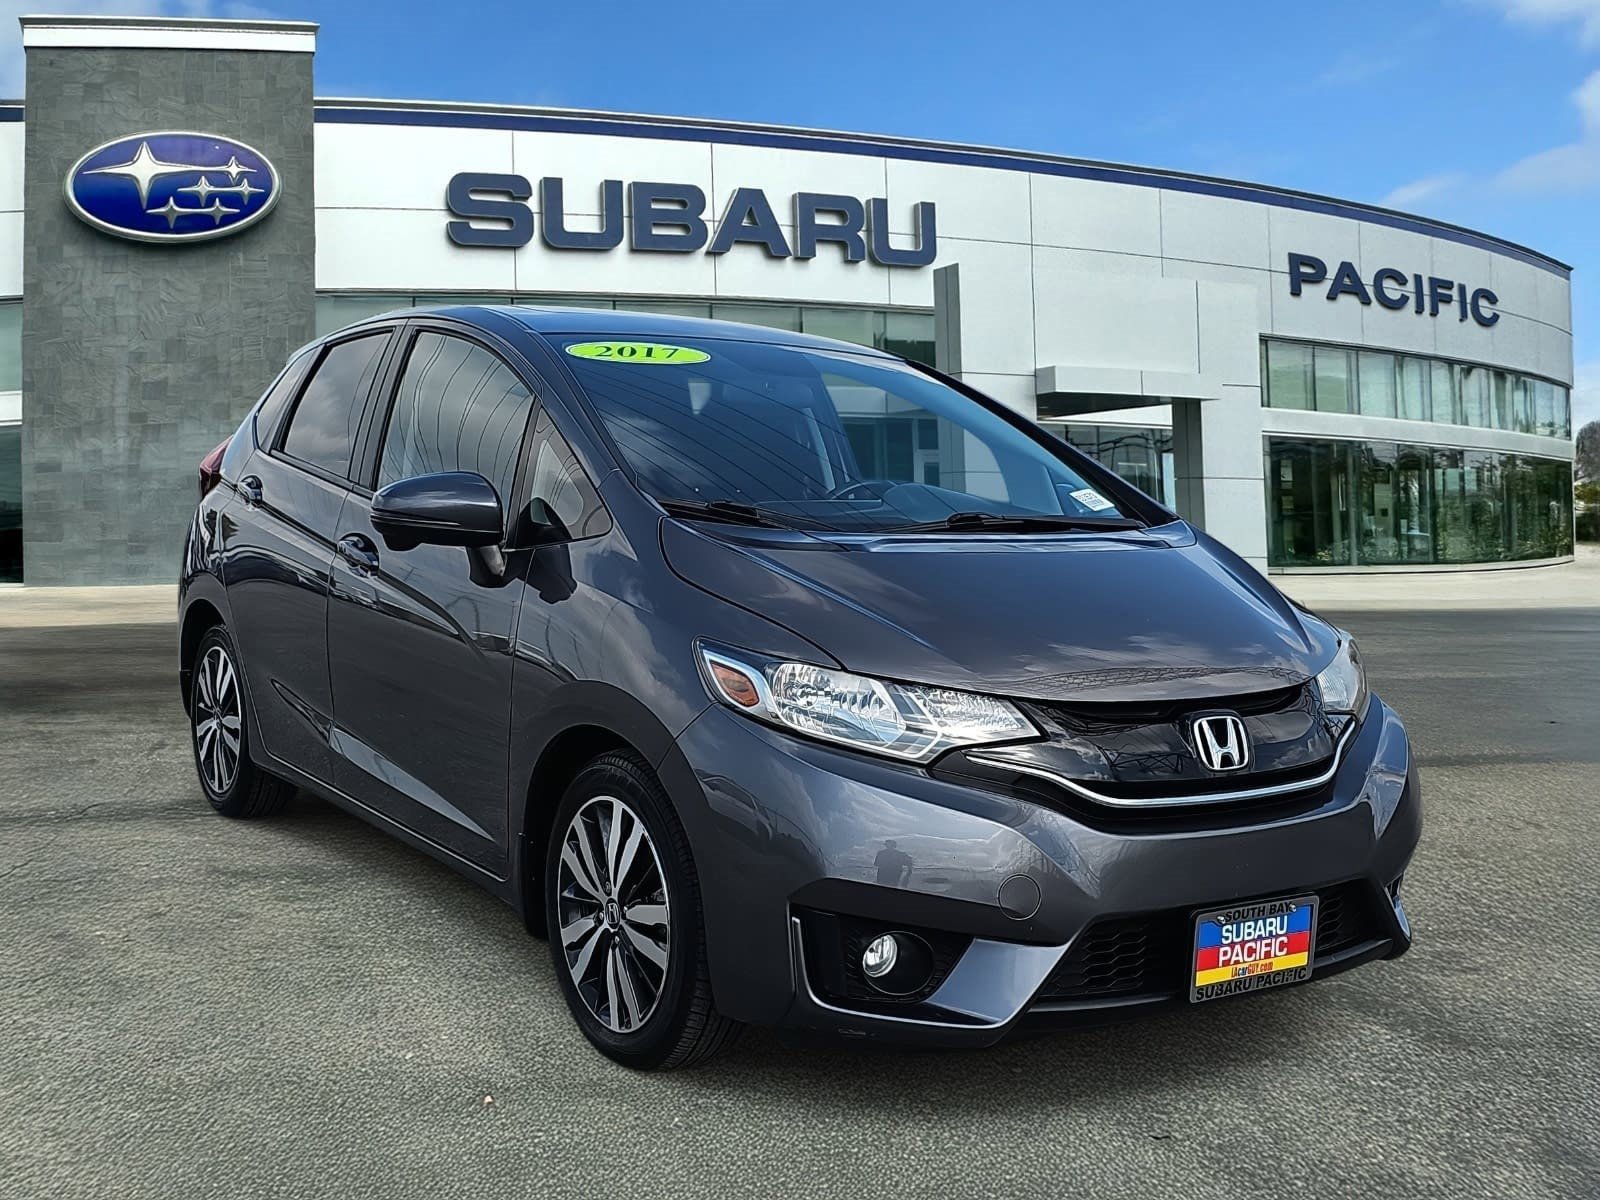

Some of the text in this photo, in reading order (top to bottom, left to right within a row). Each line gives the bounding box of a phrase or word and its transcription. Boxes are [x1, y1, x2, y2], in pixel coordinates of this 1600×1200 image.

[447, 172, 937, 268] SUBARU
[1288, 252, 1500, 327] PACIFIC
[594, 346, 680, 359] 2017
[1224, 901, 1292, 923] SOUTH BAY
[1221, 915, 1288, 945] SUBARU
[1218, 936, 1289, 968] PACIFIC
[1195, 968, 1307, 1001] SUBARU PACIFIC
